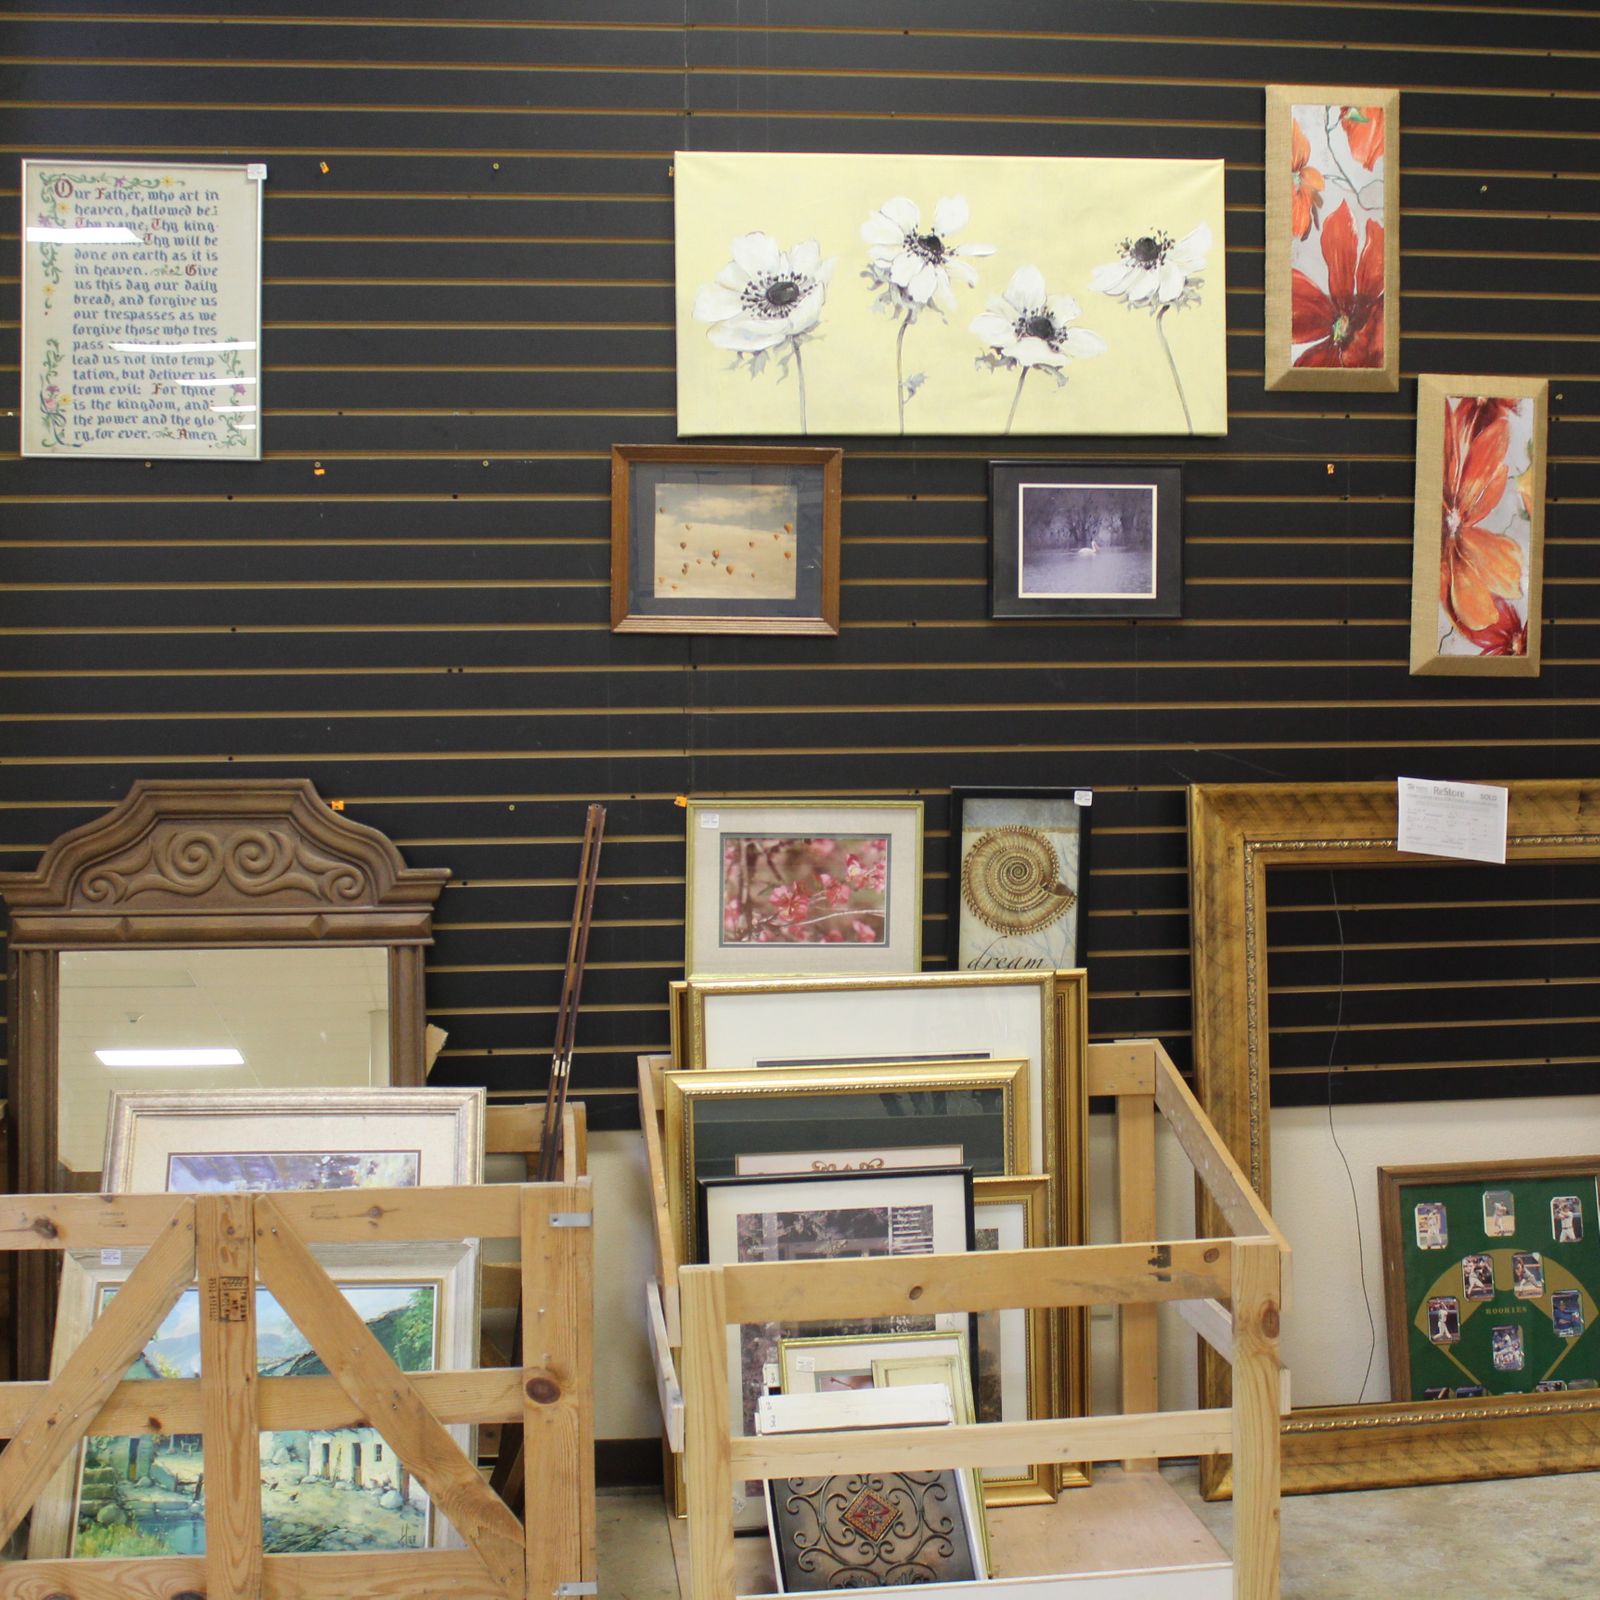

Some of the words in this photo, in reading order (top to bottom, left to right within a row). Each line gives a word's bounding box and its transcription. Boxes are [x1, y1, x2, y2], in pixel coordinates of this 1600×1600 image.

[55, 179, 91, 200] Our
[95, 187, 144, 202] Father,
[148, 190, 175, 201] who
[179, 190, 198, 201] art
[205, 190, 219, 201] in
[75, 203, 128, 216] heaven,
[131, 205, 191, 216] hallowed
[151, 218, 179, 233] Thy
[143, 233, 170, 248] Thy
[174, 236, 200, 246] will
[204, 236, 218, 246] be
[74, 248, 107, 260] done
[112, 251, 129, 260] on
[132, 249, 168, 262] earth
[172, 251, 187, 261] as
[192, 249, 201, 261] it
[206, 249, 218, 261] is
[74, 263, 89, 275] in
[94, 265, 148, 276] heaven.
[185, 264, 218, 276] Give
[74, 280, 92, 290] us
[96, 280, 122, 292] this
[126, 279, 150, 293] day
[154, 281, 179, 291] our
[184, 280, 218, 294] daily
[74, 294, 115, 306] bread,
[119, 294, 144, 305] and
[149, 294, 197, 308] forgive
[200, 297, 217, 306] us
[74, 310, 98, 319] our
[104, 309, 175, 322] trespasses
[179, 311, 194, 321] as
[198, 311, 217, 321] we
[72, 323, 122, 337] forgive
[125, 324, 160, 336] those
[162, 325, 189, 337] who
[193, 325, 217, 336] tres
[72, 341, 104, 352] pass
[72, 354, 99, 365] lead
[102, 355, 121, 365] us
[124, 354, 146, 365] not
[151, 354, 179, 365] into
[182, 355, 215, 367] temp
[122, 369, 145, 380] but
[149, 369, 195, 380] deliver
[199, 371, 217, 380] us
[72, 384, 105, 395] from
[152, 383, 177, 395] For
[181, 385, 216, 397] thine
[73, 400, 86, 410] is
[91, 399, 111, 411] the
[117, 399, 180, 412] kingdom,
[184, 399, 209, 411] and
[73, 414, 94, 427] the
[96, 415, 139, 426] power
[142, 414, 167, 425] and
[171, 414, 191, 427] the
[194, 415, 215, 428] glo
[95, 428, 115, 439] for
[118, 430, 150, 440] ever.
[177, 428, 218, 441] Amen
[1433, 785, 1465, 798] ReStore
[967, 935, 1044, 970] dream
